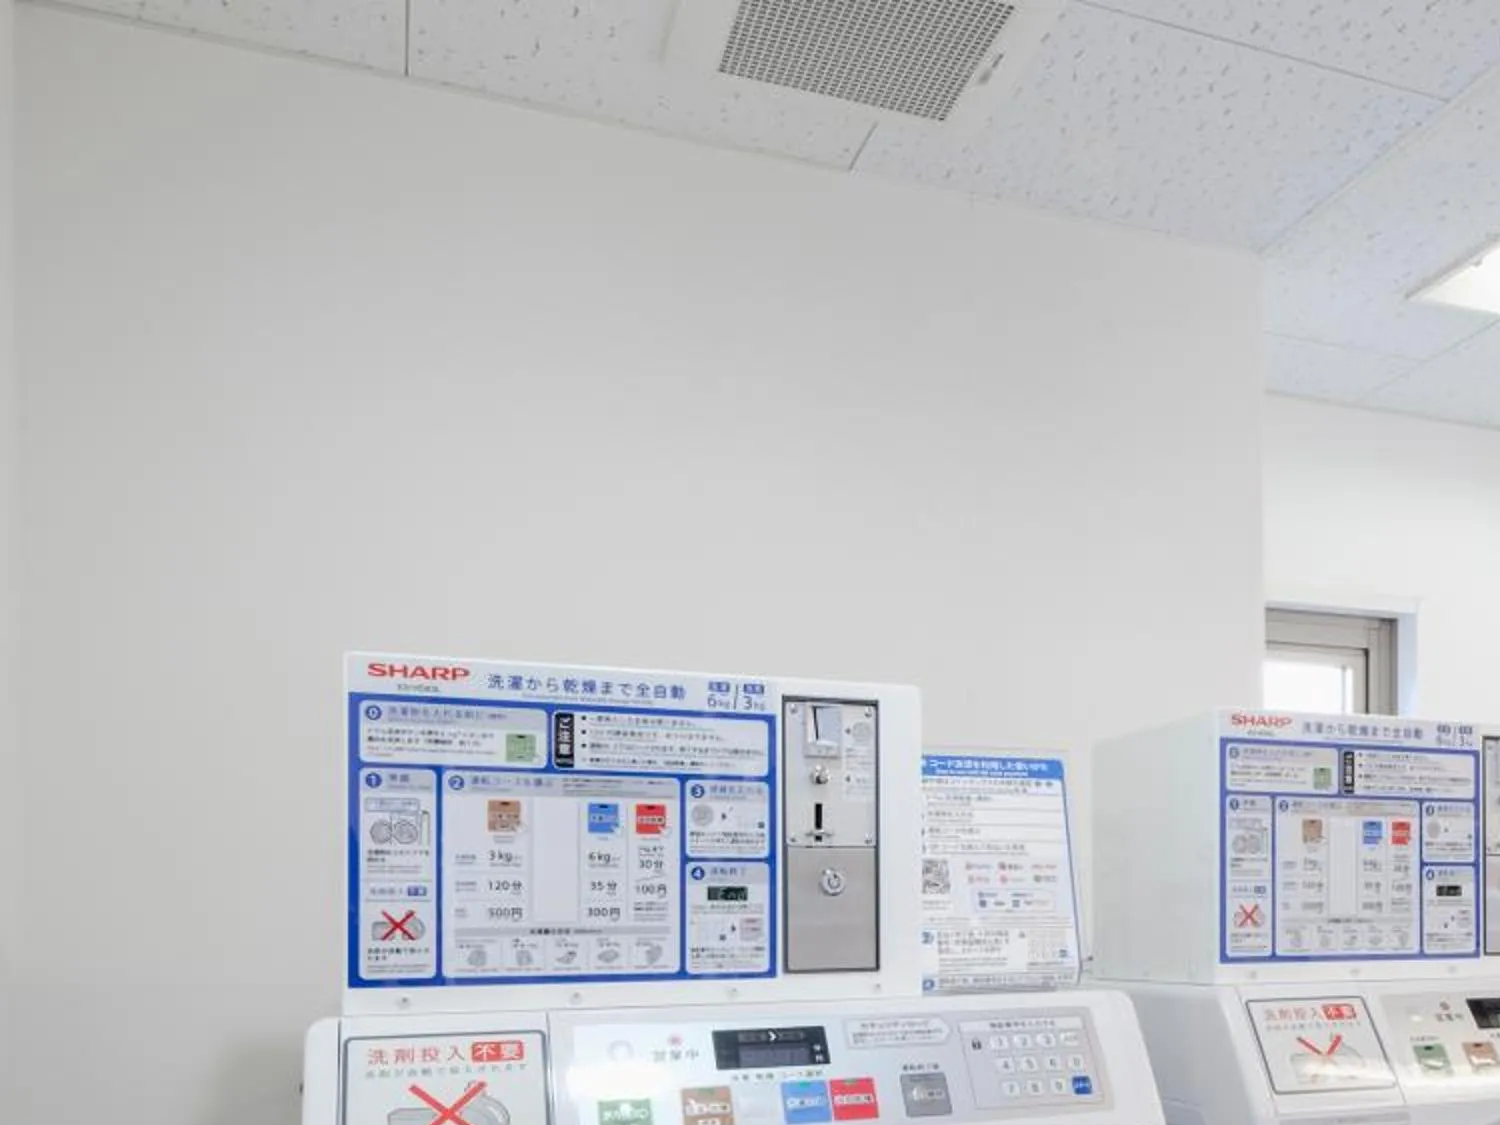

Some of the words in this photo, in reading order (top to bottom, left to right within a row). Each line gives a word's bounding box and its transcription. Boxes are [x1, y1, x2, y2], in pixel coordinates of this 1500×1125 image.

[367, 663, 470, 681] SHARP
[487, 673, 686, 700] 洗濯から乾燥まで全自動
[1231, 714, 1292, 729] SHARP
[367, 1044, 465, 1066] 洗剤投入
